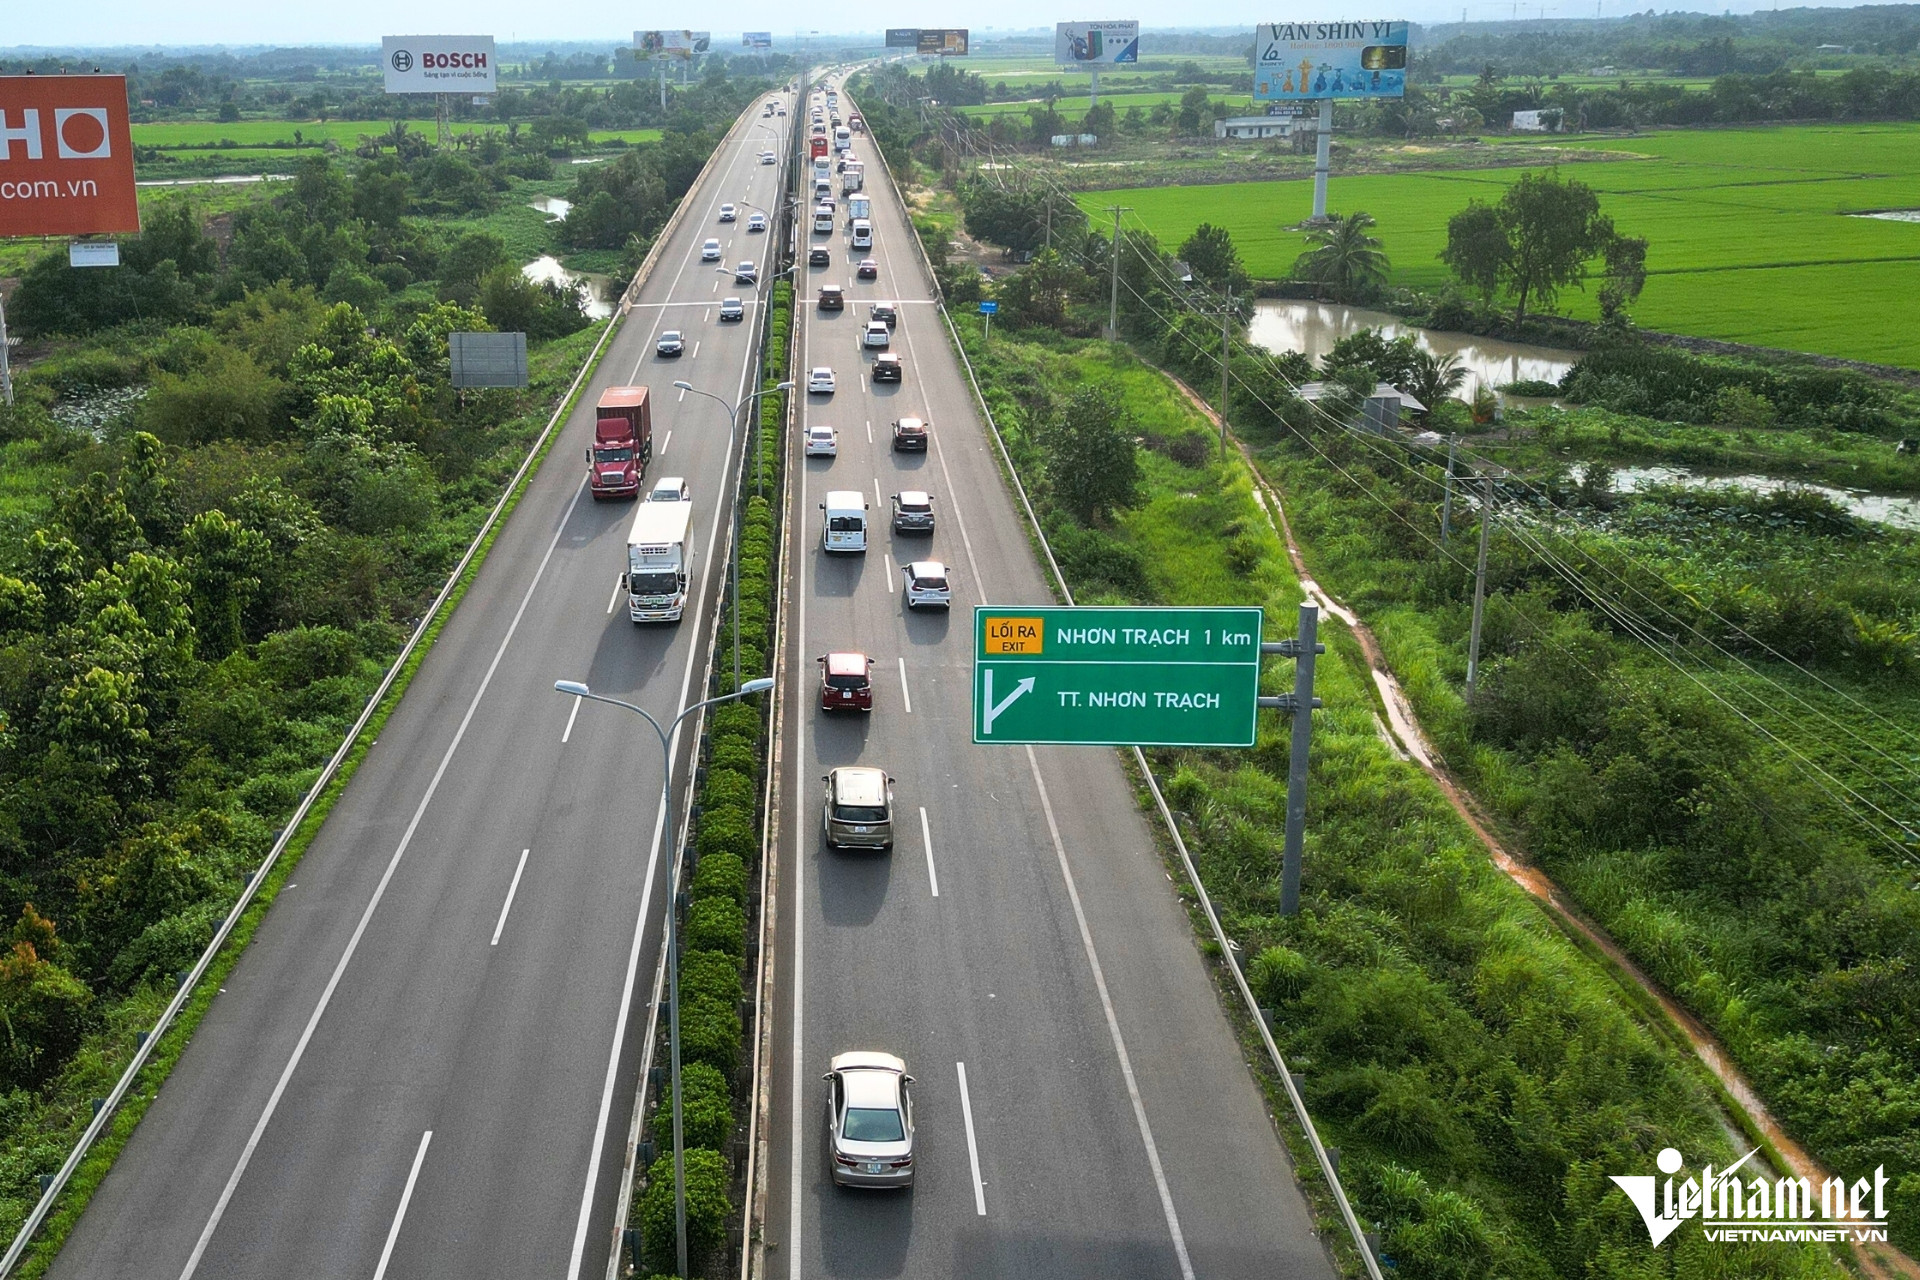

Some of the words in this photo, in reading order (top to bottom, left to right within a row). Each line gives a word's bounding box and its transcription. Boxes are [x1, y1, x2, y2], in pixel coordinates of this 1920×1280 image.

[1316, 23, 1365, 40] SHIN
[1371, 22, 1392, 38] YI
[423, 53, 487, 68] BOSCH
[991, 621, 1013, 638] LỐI
[1018, 625, 1036, 638] RA
[1057, 628, 1116, 645] NHƠN
[1122, 629, 1190, 648] TRẠCH
[1204, 630, 1211, 645] 1
[1222, 629, 1251, 645] km
[1002, 641, 1025, 652] EXIT
[1057, 691, 1082, 707] TT.
[1089, 690, 1146, 708] NHƠN
[1154, 692, 1220, 712] TRẠCH
